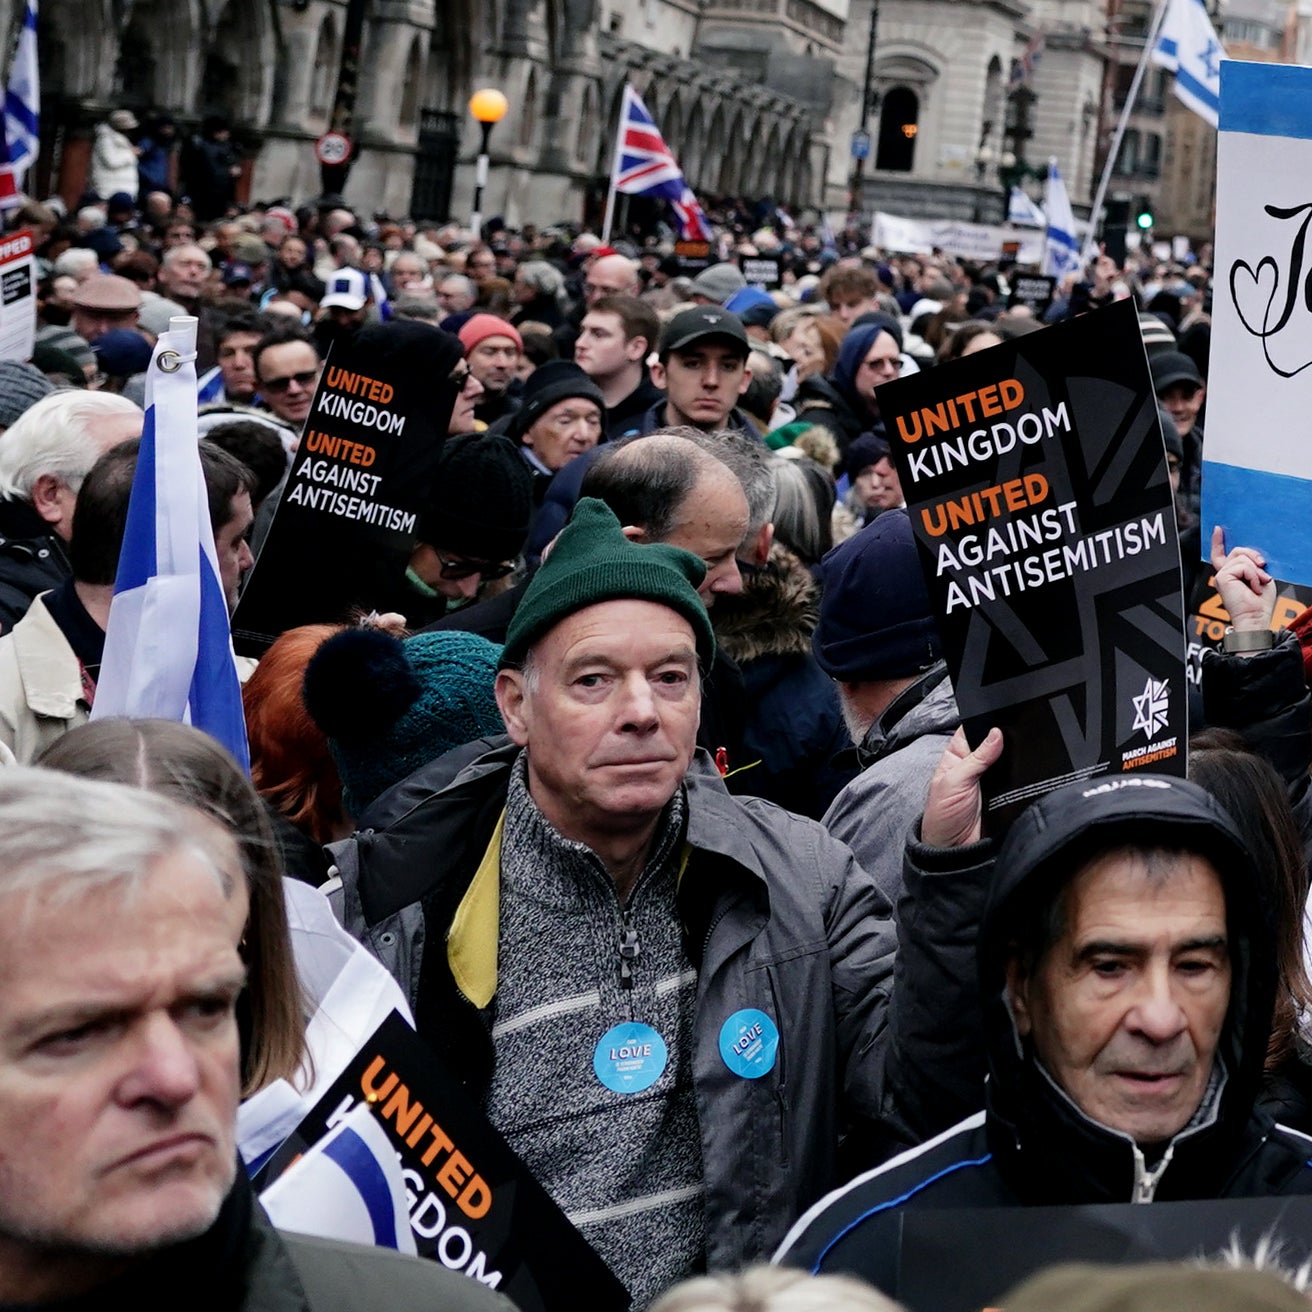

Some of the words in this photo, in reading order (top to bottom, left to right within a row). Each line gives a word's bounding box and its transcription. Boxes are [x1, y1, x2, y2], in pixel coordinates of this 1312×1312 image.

[326, 365, 395, 405] UNITED
[317, 391, 406, 437] KINGDOM
[895, 378, 1025, 444] UNITED
[305, 429, 377, 467] UNITED
[906, 401, 1072, 483] KINGDOM
[296, 456, 383, 497] AGAINST
[286, 482, 417, 535] ANTISEMITISM
[920, 473, 1049, 538] UNITED
[936, 500, 1078, 577] AGAINST
[945, 512, 1167, 615] ANTISEMITISM
[1122, 746, 1147, 761] MARCH
[1147, 736, 1177, 754] AGAINST
[1122, 746, 1177, 771] ANTISEMITISM
[609, 1043, 653, 1061] LOVE
[732, 1021, 764, 1057] LOVE
[360, 1054, 493, 1220] UNITED
